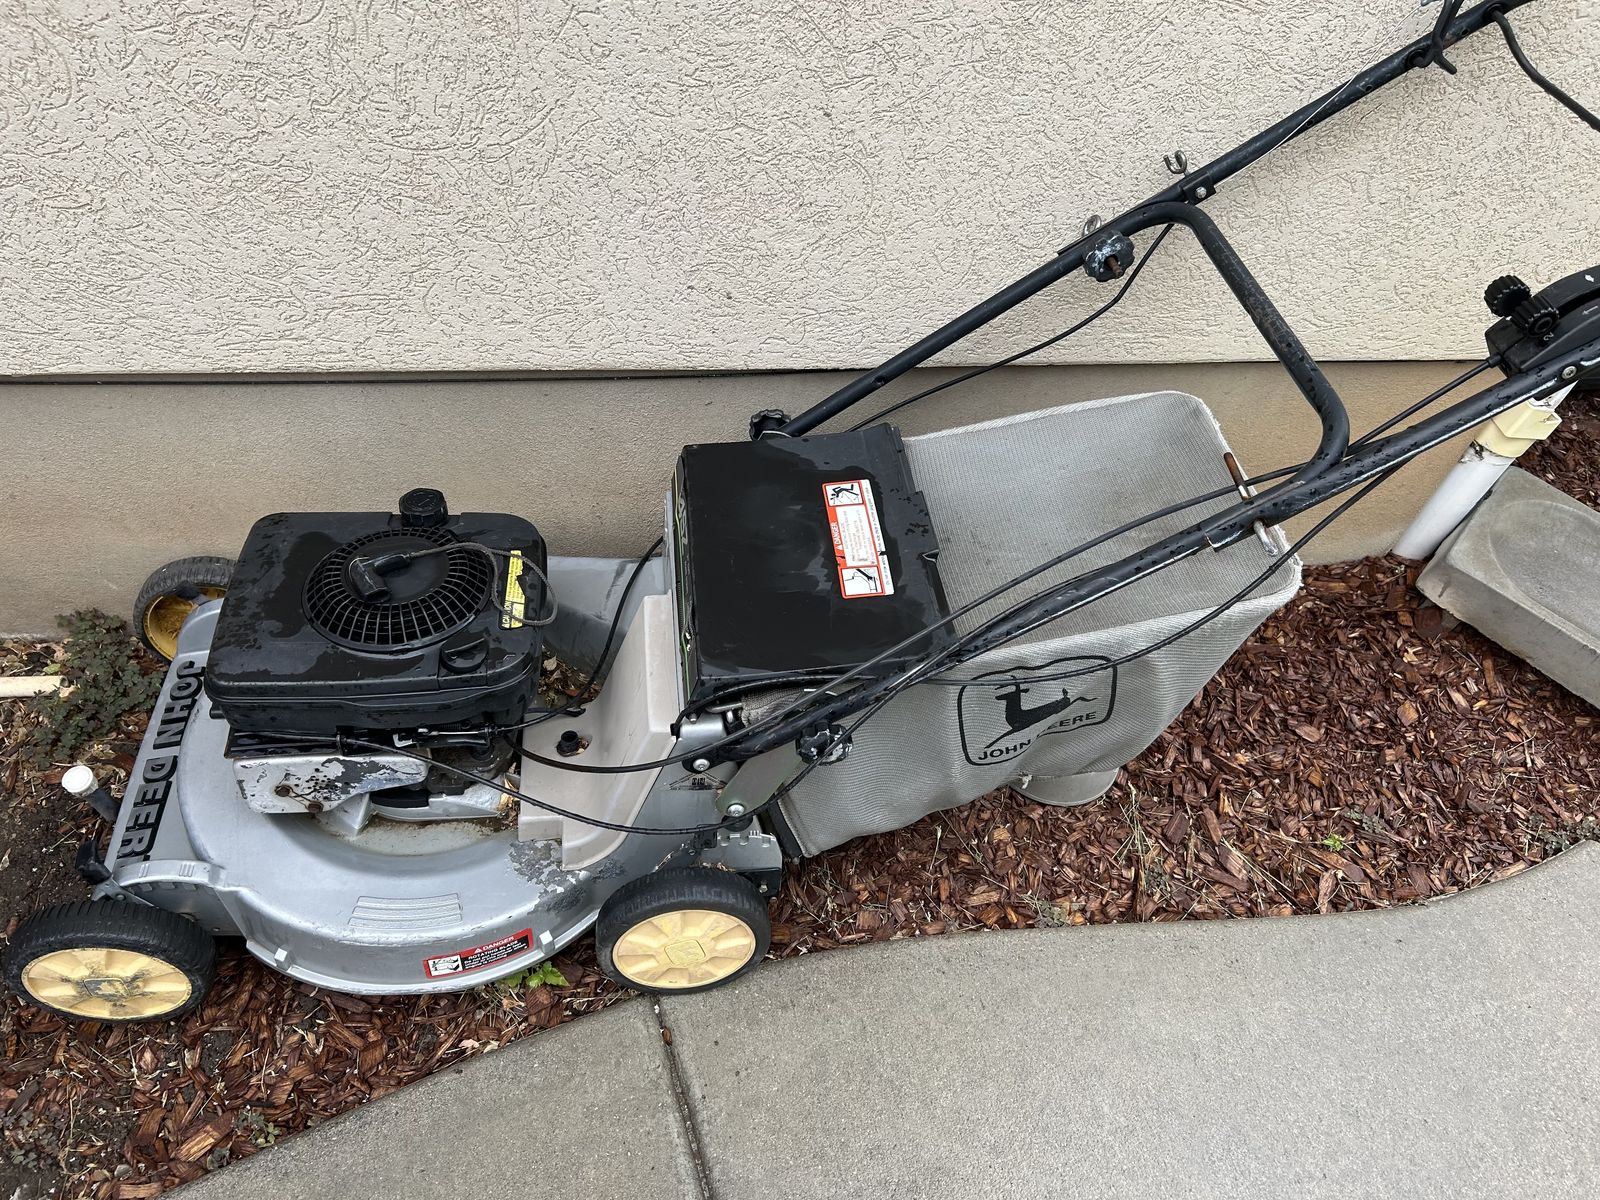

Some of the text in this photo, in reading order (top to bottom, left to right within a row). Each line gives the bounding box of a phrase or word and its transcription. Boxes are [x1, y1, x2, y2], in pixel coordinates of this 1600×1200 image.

[978, 739, 1031, 761] JOHN
[116, 660, 206, 868] JOHN DEER
[482, 936, 514, 951] DANGER
[468, 948, 498, 960] ROTATING
